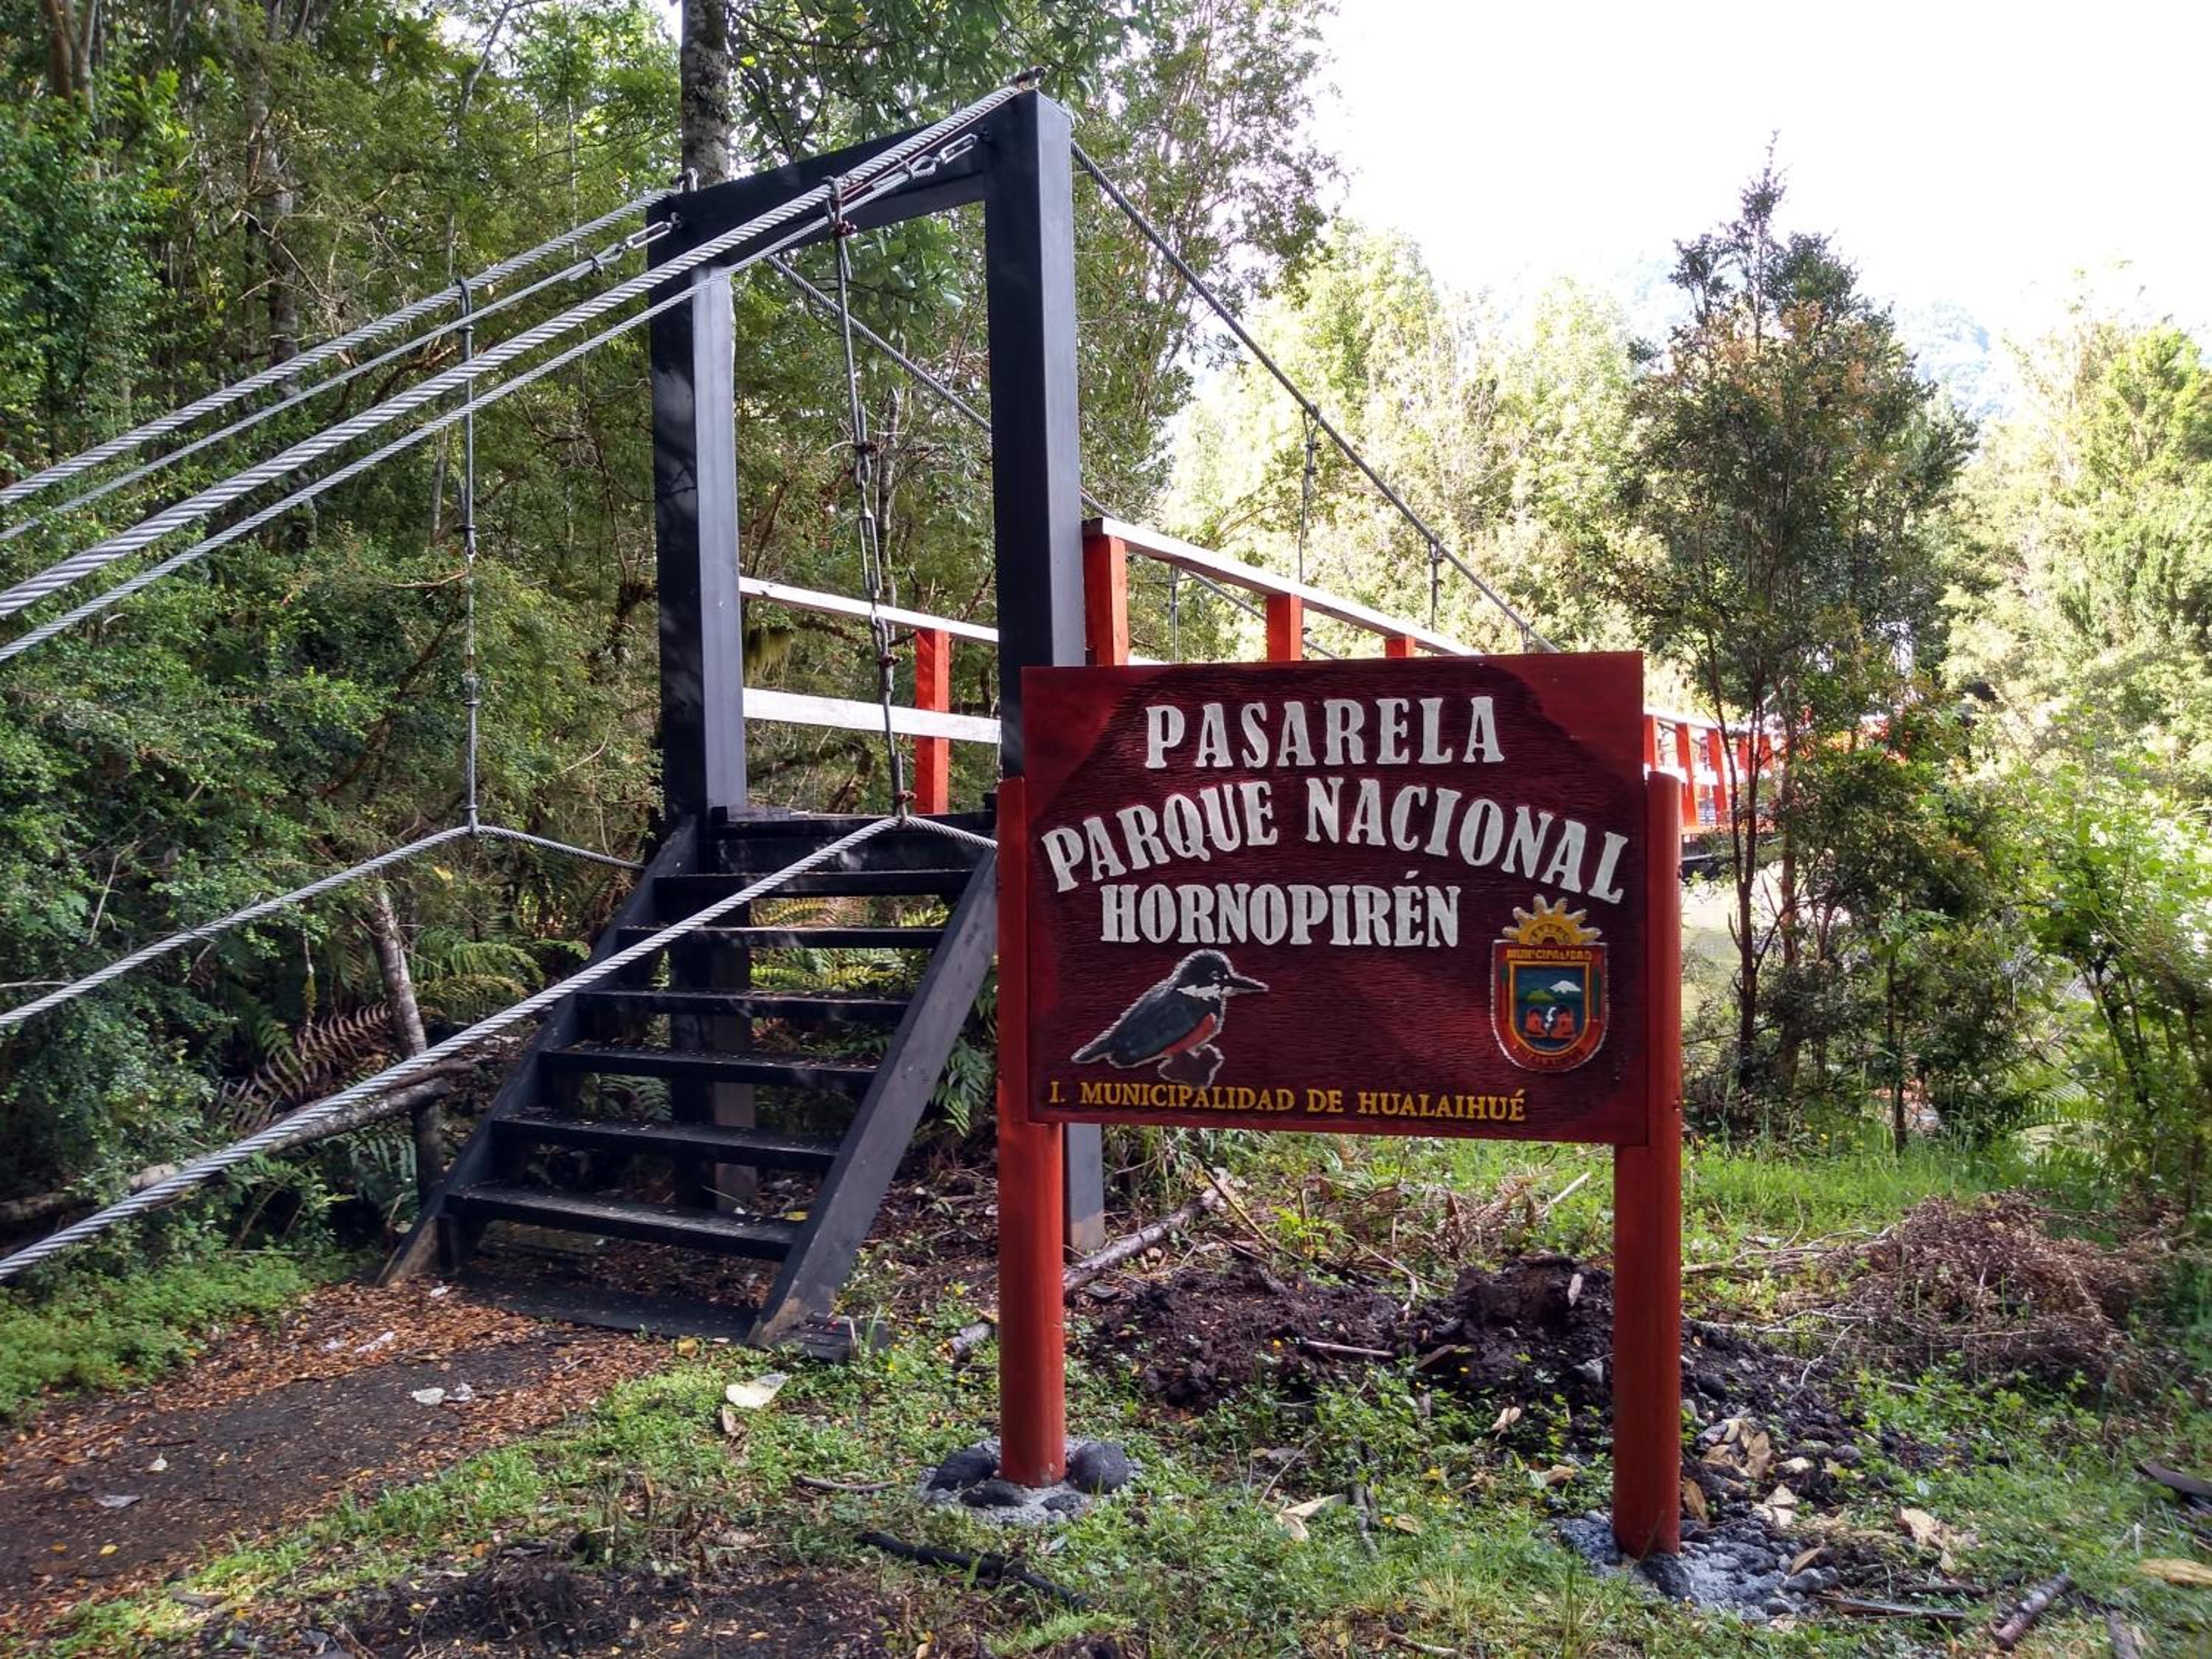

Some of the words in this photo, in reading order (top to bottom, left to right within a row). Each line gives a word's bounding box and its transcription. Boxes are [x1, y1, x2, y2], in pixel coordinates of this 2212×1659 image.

[1145, 695, 1505, 769] PASARELA
[1040, 780, 1278, 893] PARQUE
[1305, 776, 1629, 905] NACIONAL
[1099, 871, 1461, 947] HORNOPIRÉN
[1079, 1082, 1295, 1112] MUNICIPALIDAD
[1307, 1089, 1344, 1113] DE
[1357, 1089, 1526, 1121] HUALAIHUÉ
